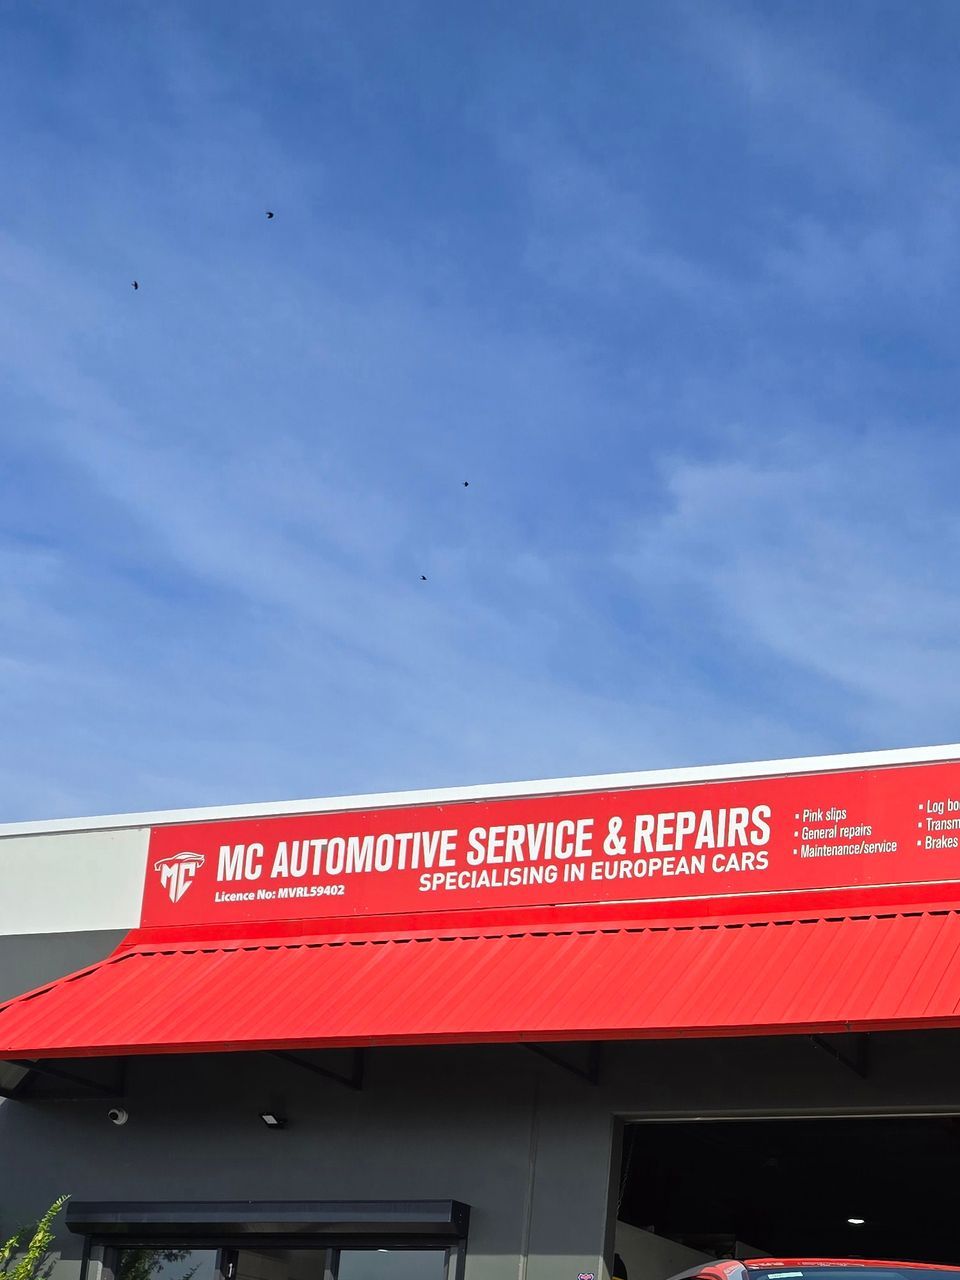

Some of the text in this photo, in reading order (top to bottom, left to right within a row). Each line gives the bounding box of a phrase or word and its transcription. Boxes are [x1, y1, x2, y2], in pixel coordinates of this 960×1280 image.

[803, 807, 848, 824] Pink slips
[926, 800, 945, 815] Log
[801, 823, 873, 841] General repairs
[217, 804, 772, 882] MC AUTOMOTIVE SERVICE & REPAIRS
[800, 840, 898, 858] Maintenance/service
[925, 834, 959, 850] Brakes
[418, 851, 769, 892] SPECIALISING IN EUROPEAN CARS
[214, 884, 345, 903] Licence No: MVRL59402
